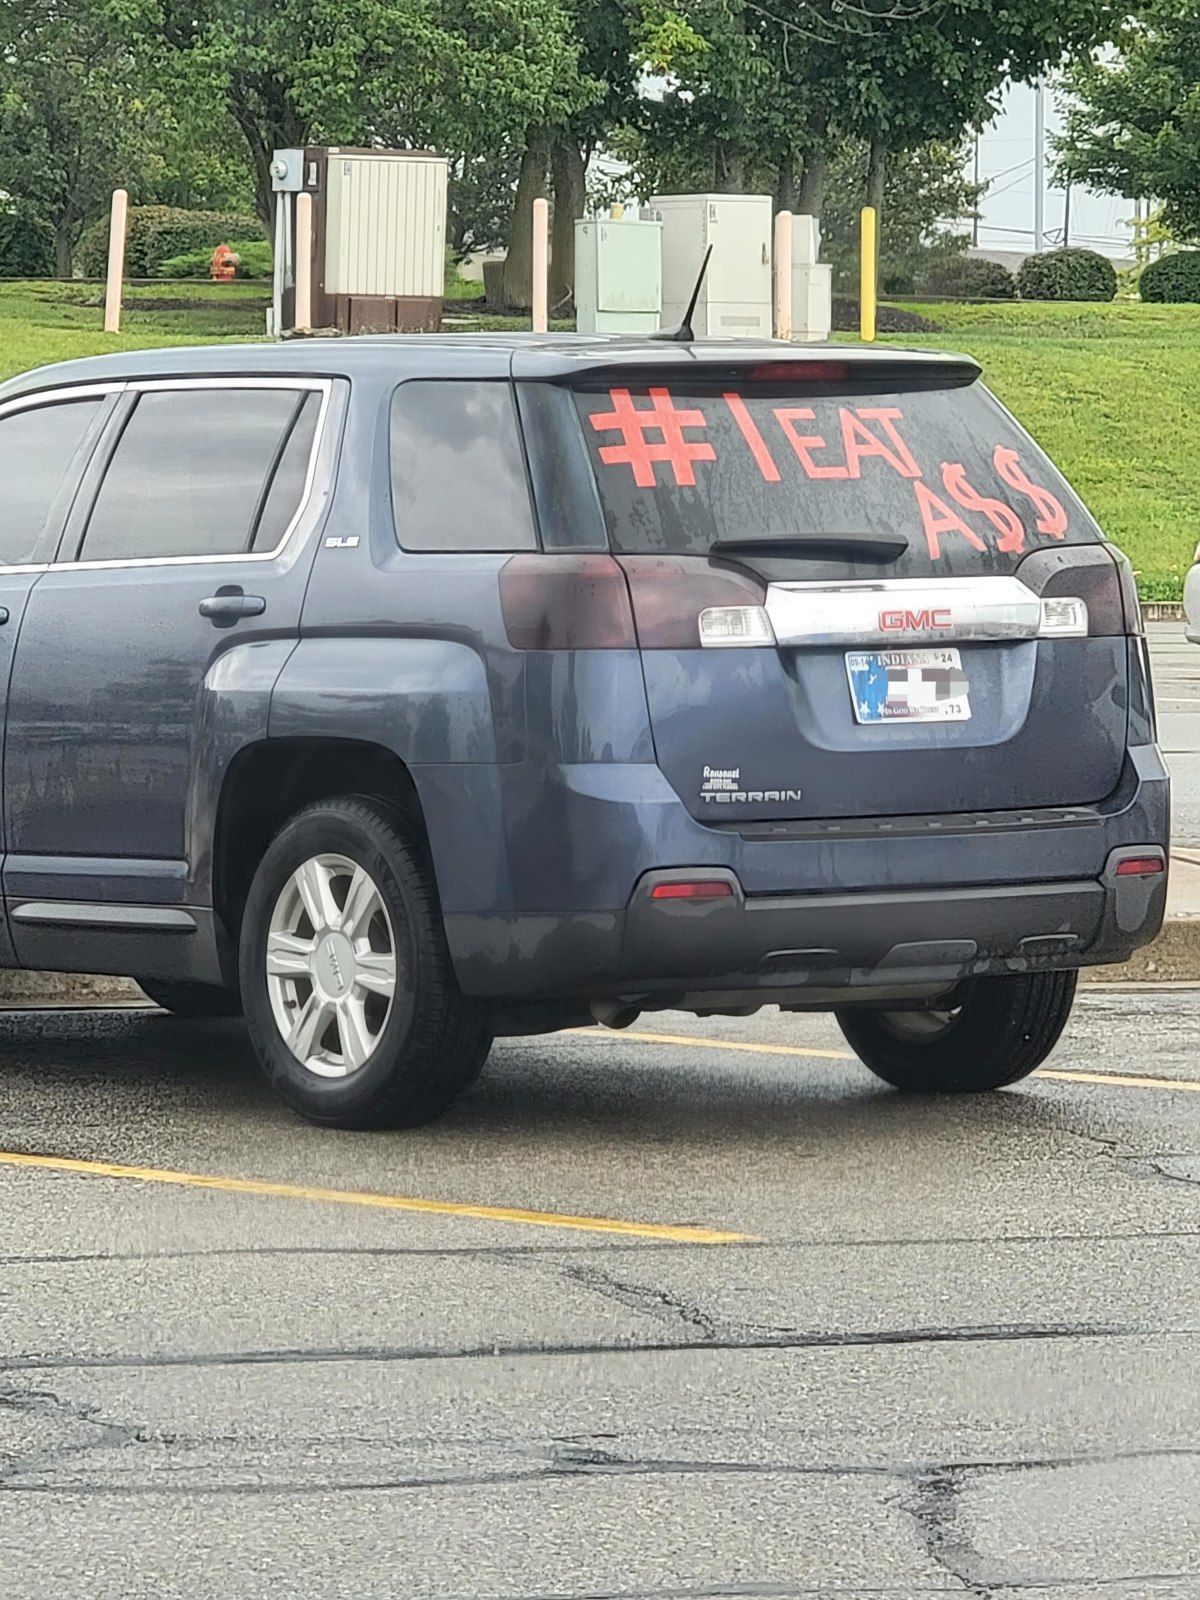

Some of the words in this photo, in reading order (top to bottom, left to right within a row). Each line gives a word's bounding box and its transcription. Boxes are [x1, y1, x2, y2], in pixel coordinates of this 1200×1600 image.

[879, 609, 953, 632] GMC
[876, 652, 931, 667] INDIANA
[940, 653, 953, 663] 24
[700, 790, 801, 803] TERRAIN
